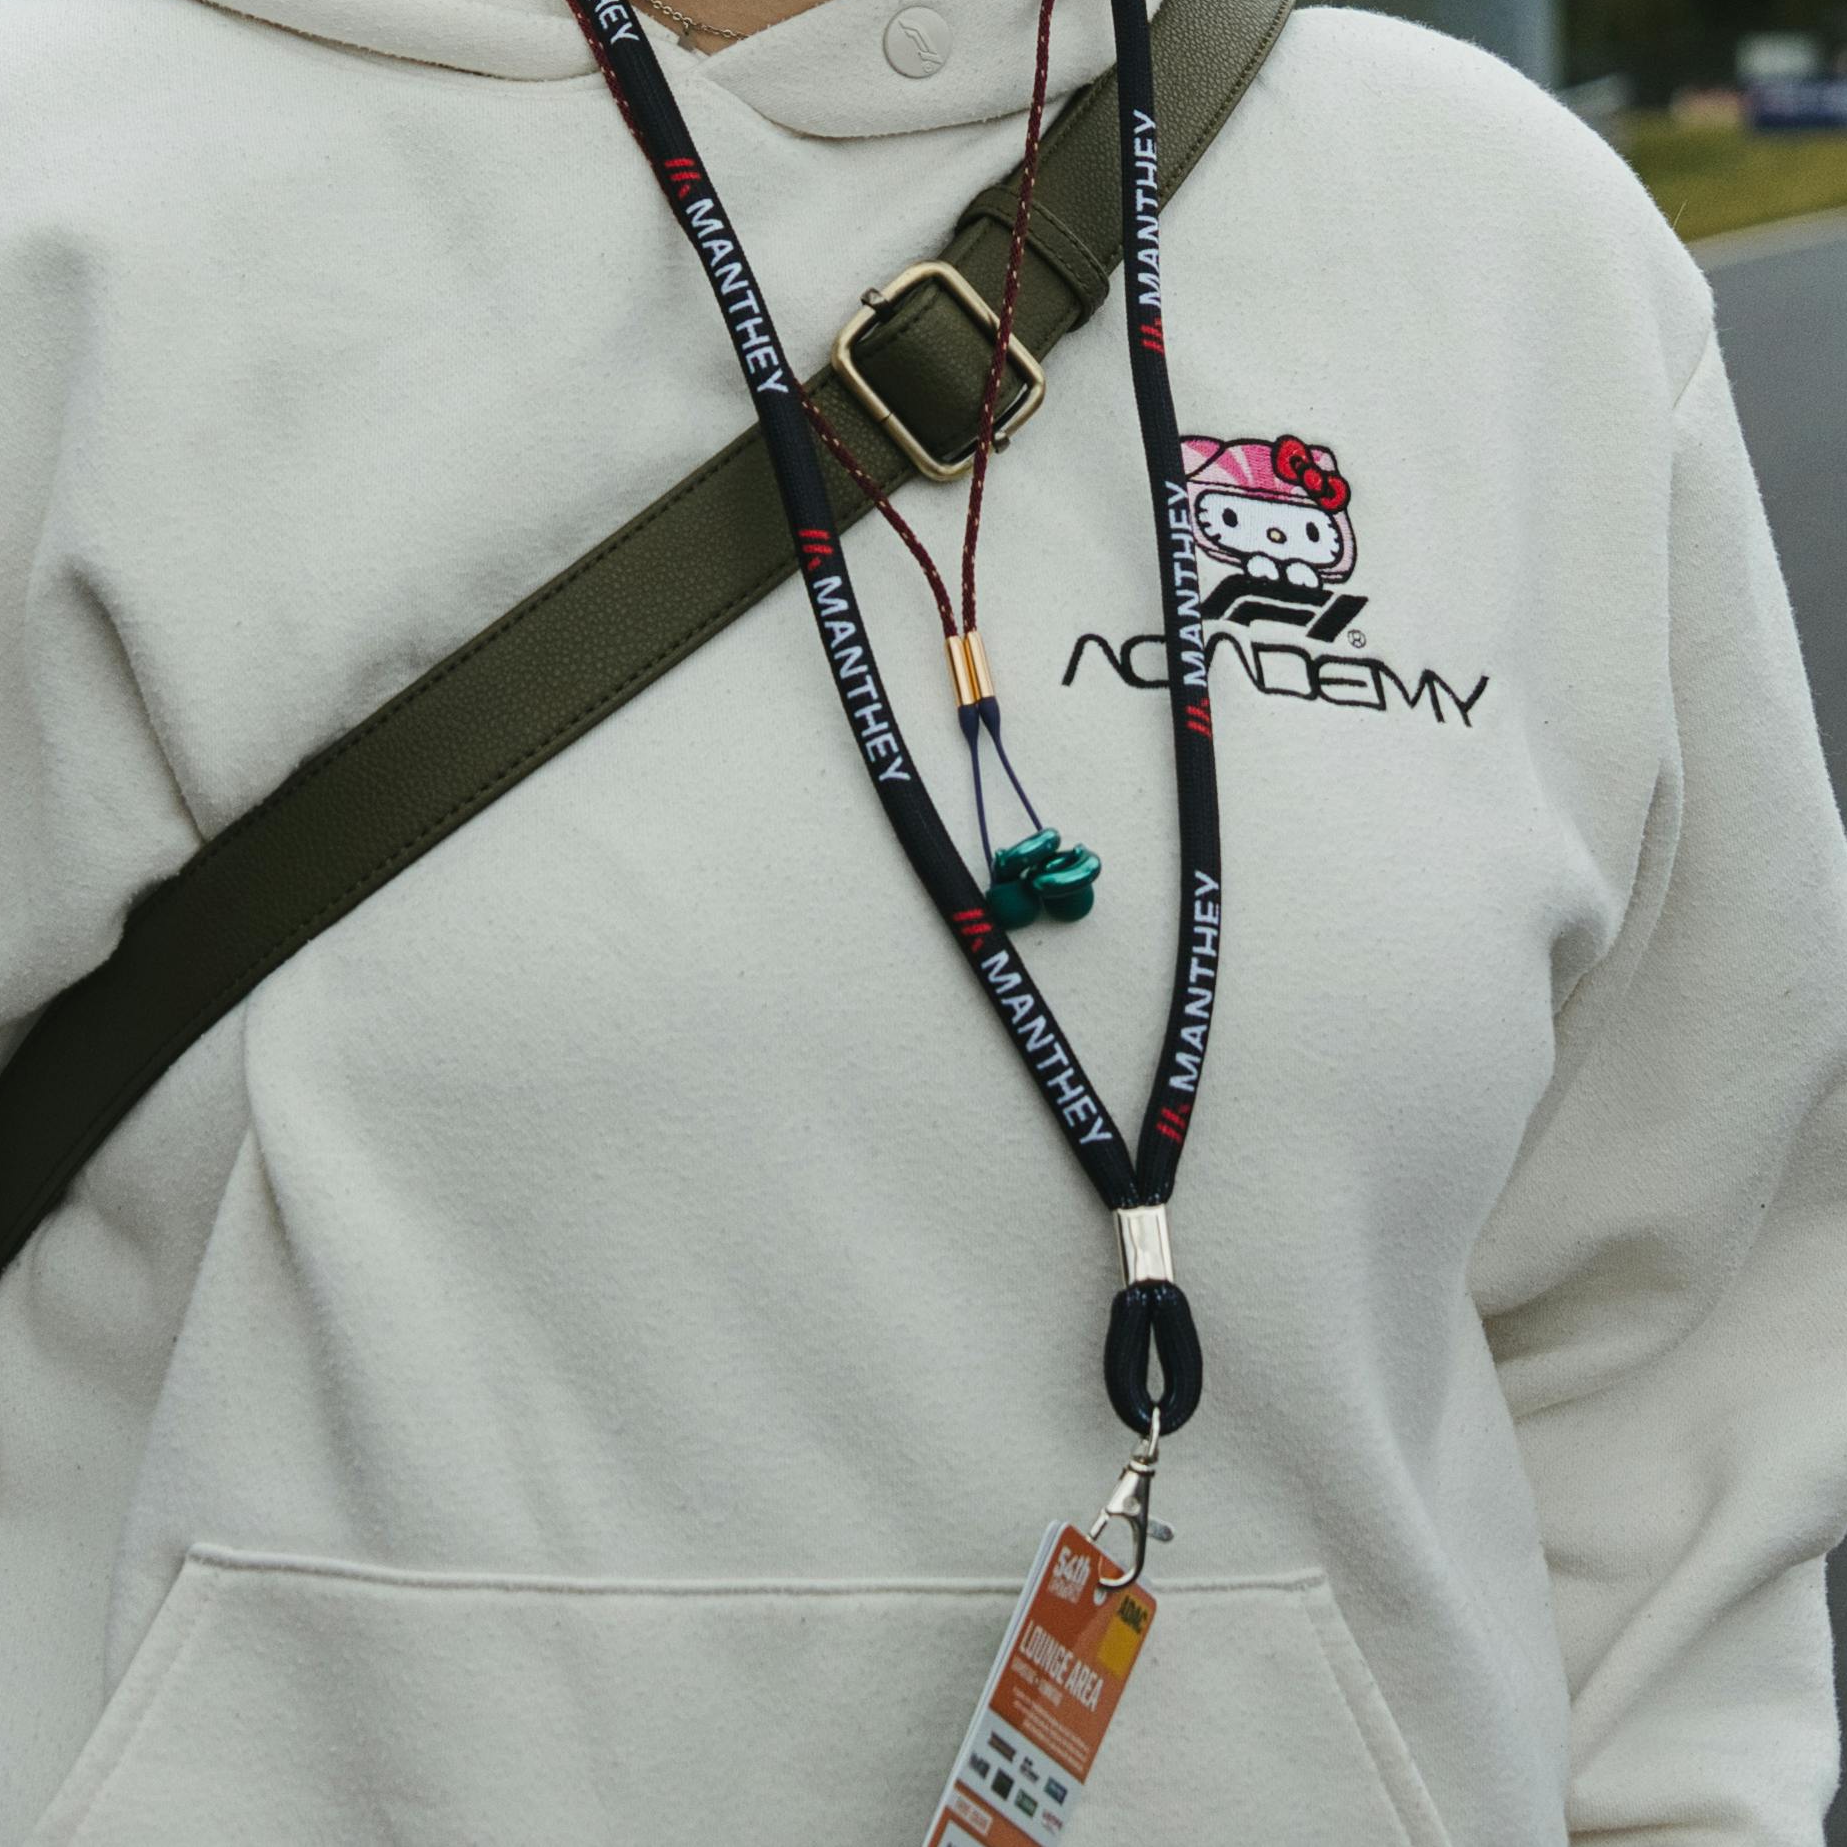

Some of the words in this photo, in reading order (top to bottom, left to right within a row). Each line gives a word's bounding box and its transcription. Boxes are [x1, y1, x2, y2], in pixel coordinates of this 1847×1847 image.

[685, 197, 789, 394] MANTHEY
[1132, 109, 1162, 308] MANTHEY
[812, 574, 912, 782] MANTHEY
[1164, 481, 1209, 688] MANTHEY
[980, 949, 1114, 1145] MANTHEY
[1168, 870, 1221, 1093] MANTHEY
[1019, 1620, 1074, 1686] LOUNGE
[1064, 1659, 1104, 1713] AREA
